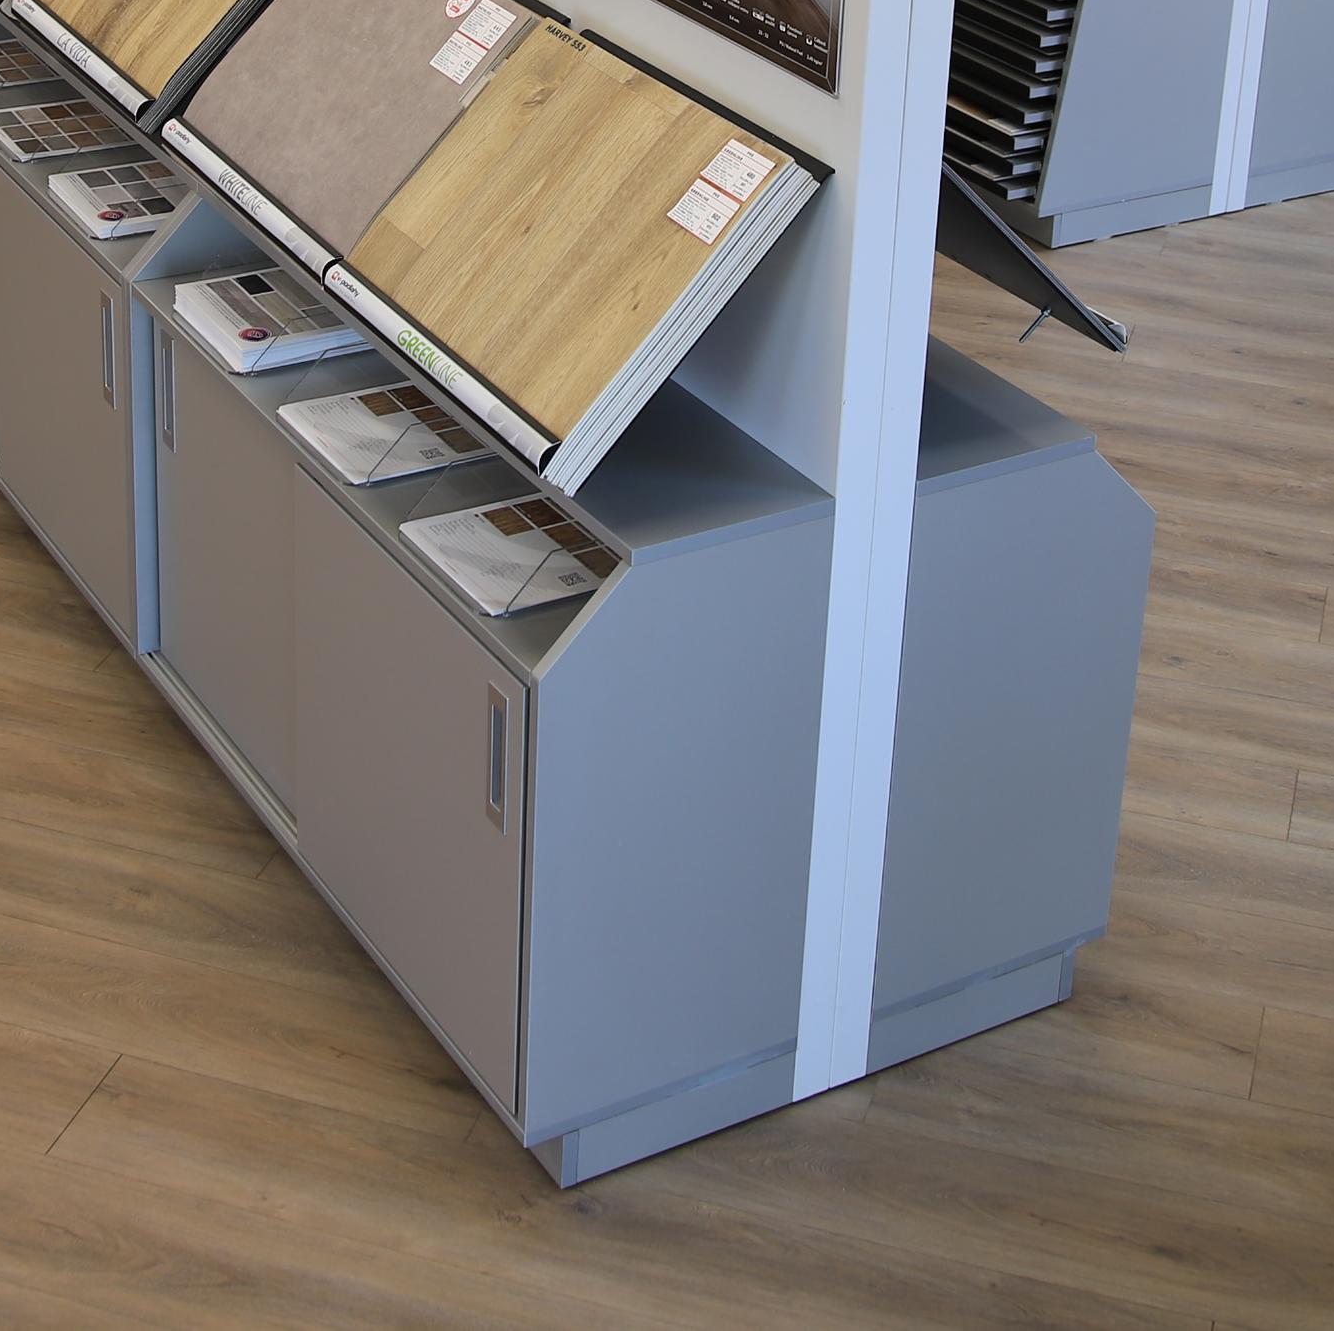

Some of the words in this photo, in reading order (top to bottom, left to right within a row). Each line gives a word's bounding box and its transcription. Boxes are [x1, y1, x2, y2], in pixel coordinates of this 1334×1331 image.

[56, 32, 72, 52] LA
[68, 41, 92, 69] VIDA
[545, 24, 572, 44] HARVEY
[570, 38, 587, 52] 553
[217, 169, 269, 217] WHITELINE
[397, 328, 465, 390] GREENLINE
